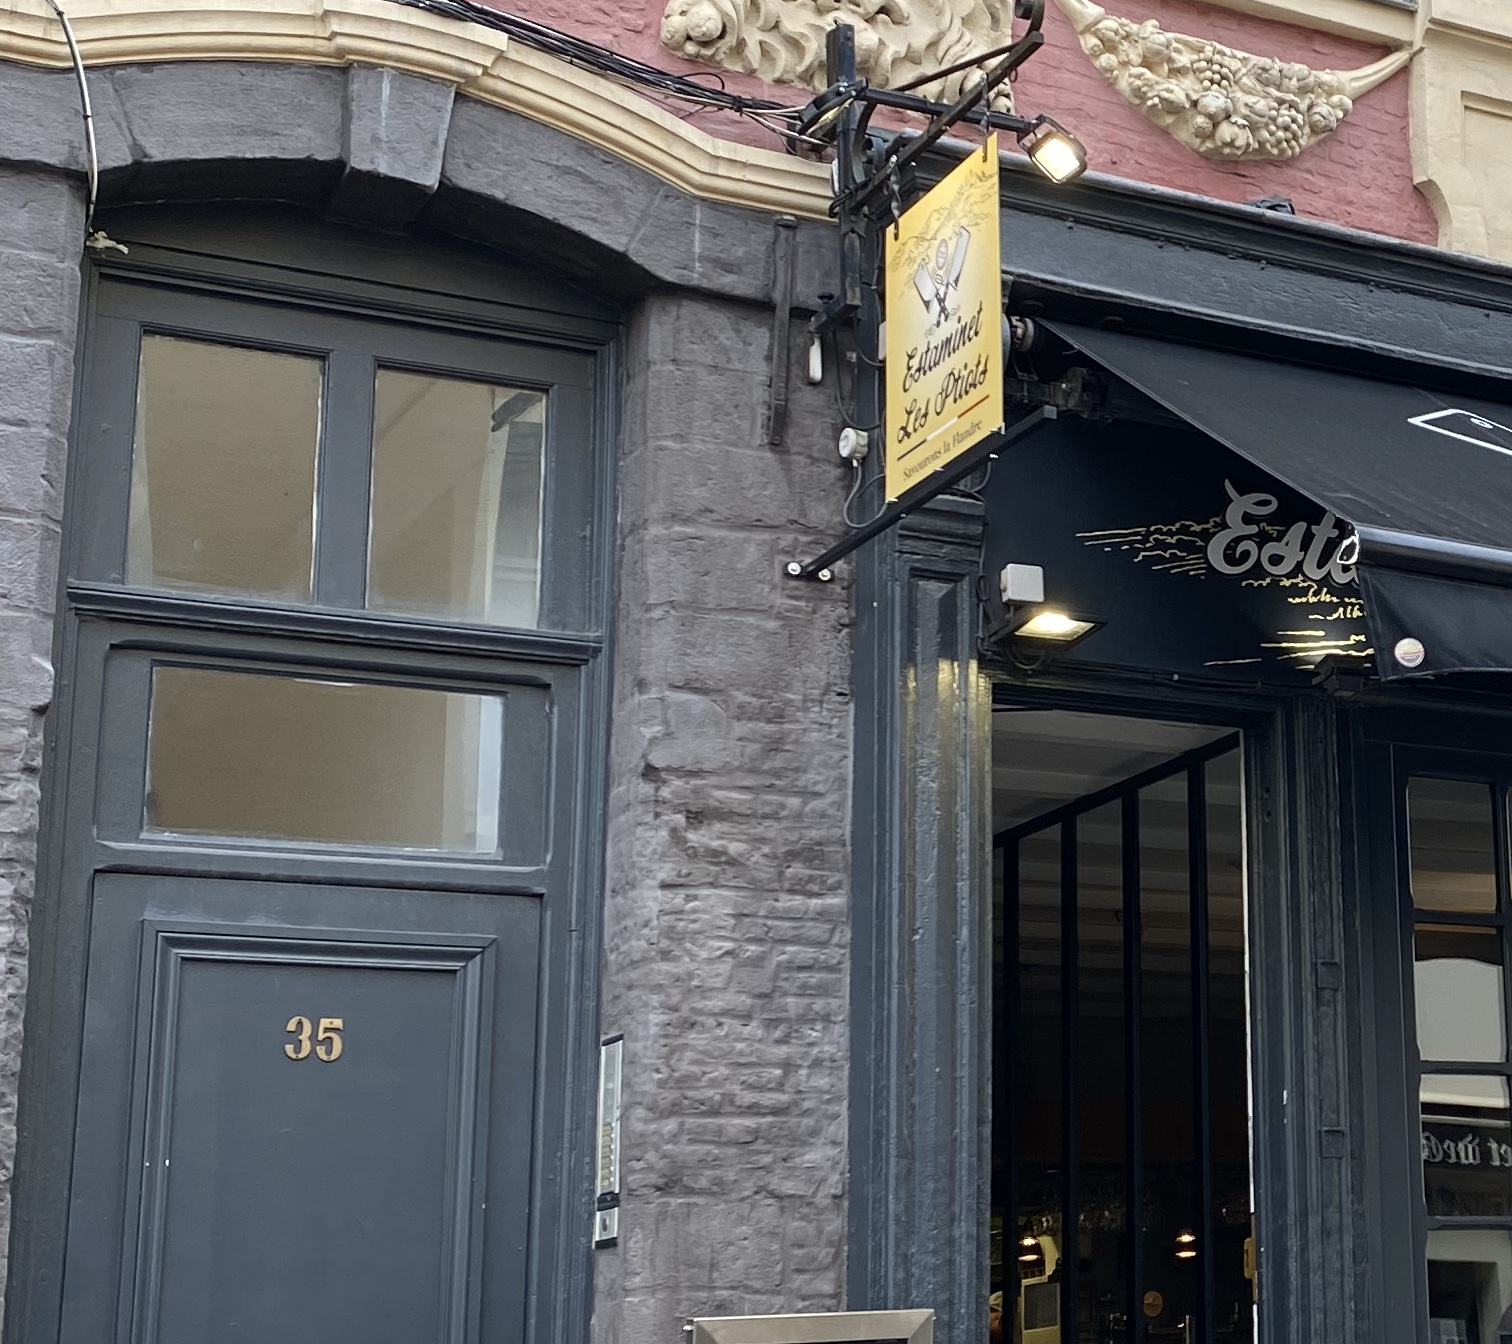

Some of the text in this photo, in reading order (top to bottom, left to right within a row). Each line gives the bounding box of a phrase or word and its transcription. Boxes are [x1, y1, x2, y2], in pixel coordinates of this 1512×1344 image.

[902, 300, 983, 393] Estaminet
[896, 353, 990, 444] Les Ptiots
[952, 420, 983, 447] Flandre
[1207, 479, 1360, 585] Esta
[284, 1015, 344, 1062] 35
